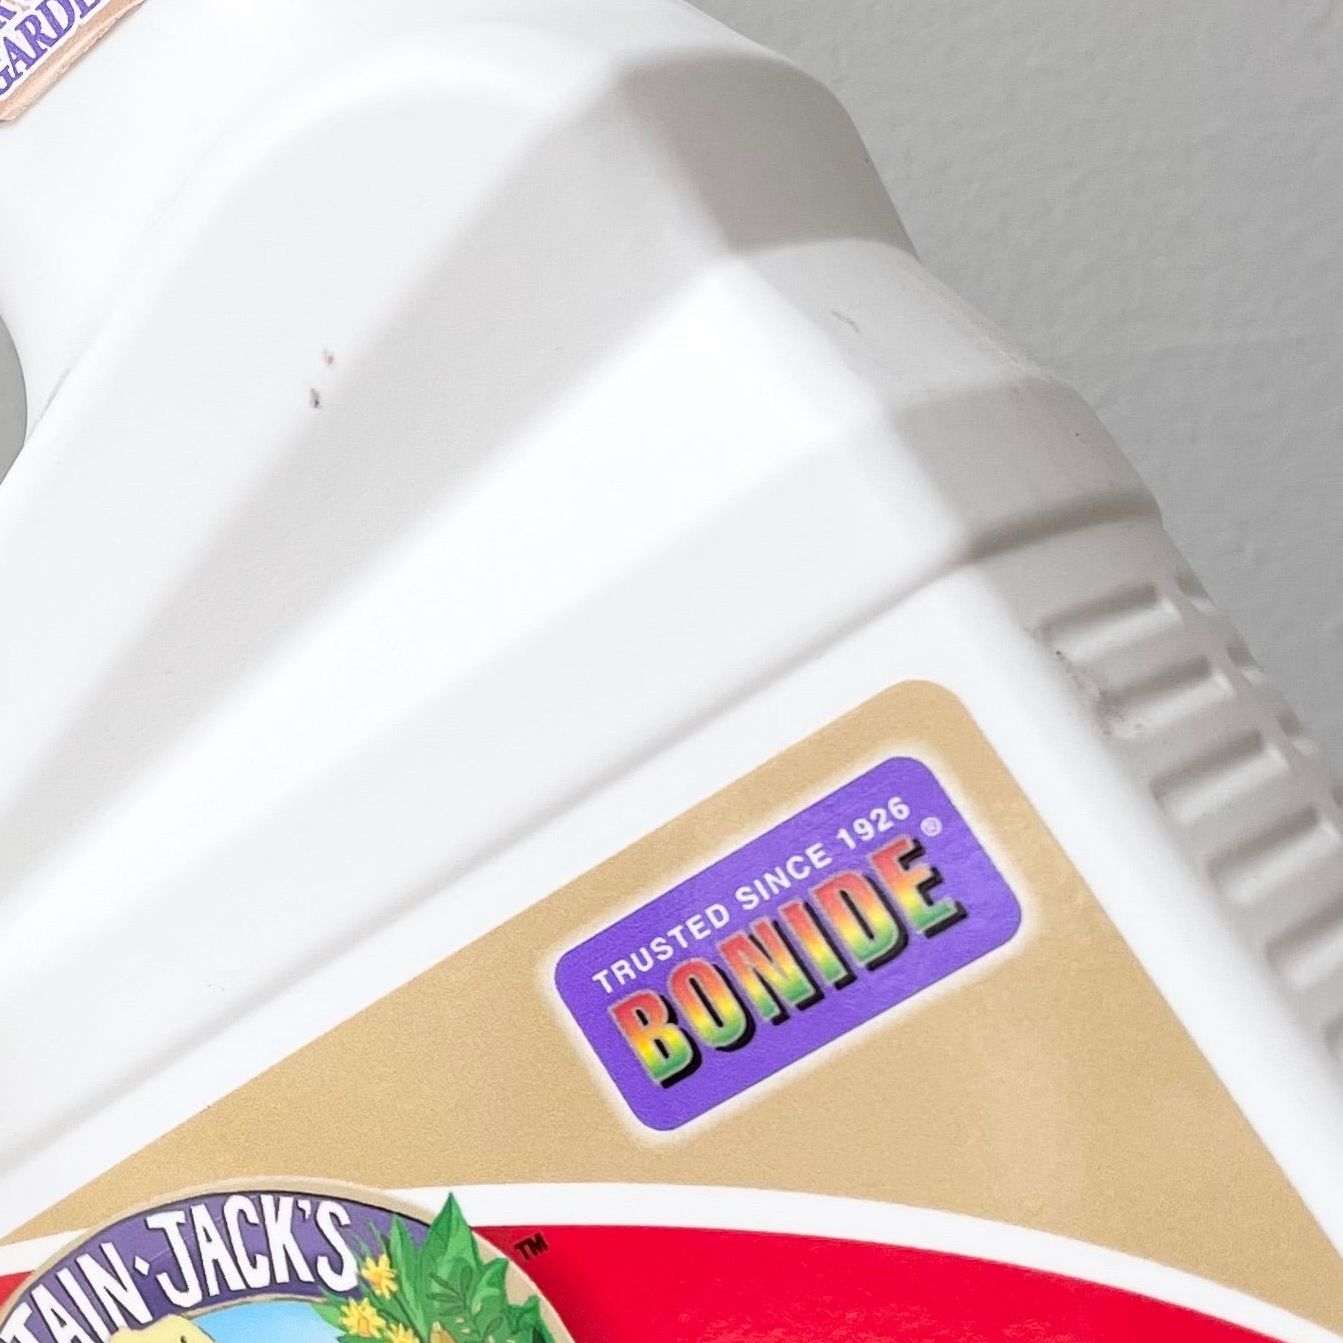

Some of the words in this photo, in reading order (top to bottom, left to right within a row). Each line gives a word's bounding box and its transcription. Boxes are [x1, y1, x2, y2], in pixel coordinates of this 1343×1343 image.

[592, 903, 730, 994] TRUSTED
[735, 843, 832, 911] SINCE
[836, 797, 911, 850] 1926
[609, 834, 967, 1088] BONIDE
[147, 1193, 358, 1308] JACK'S
